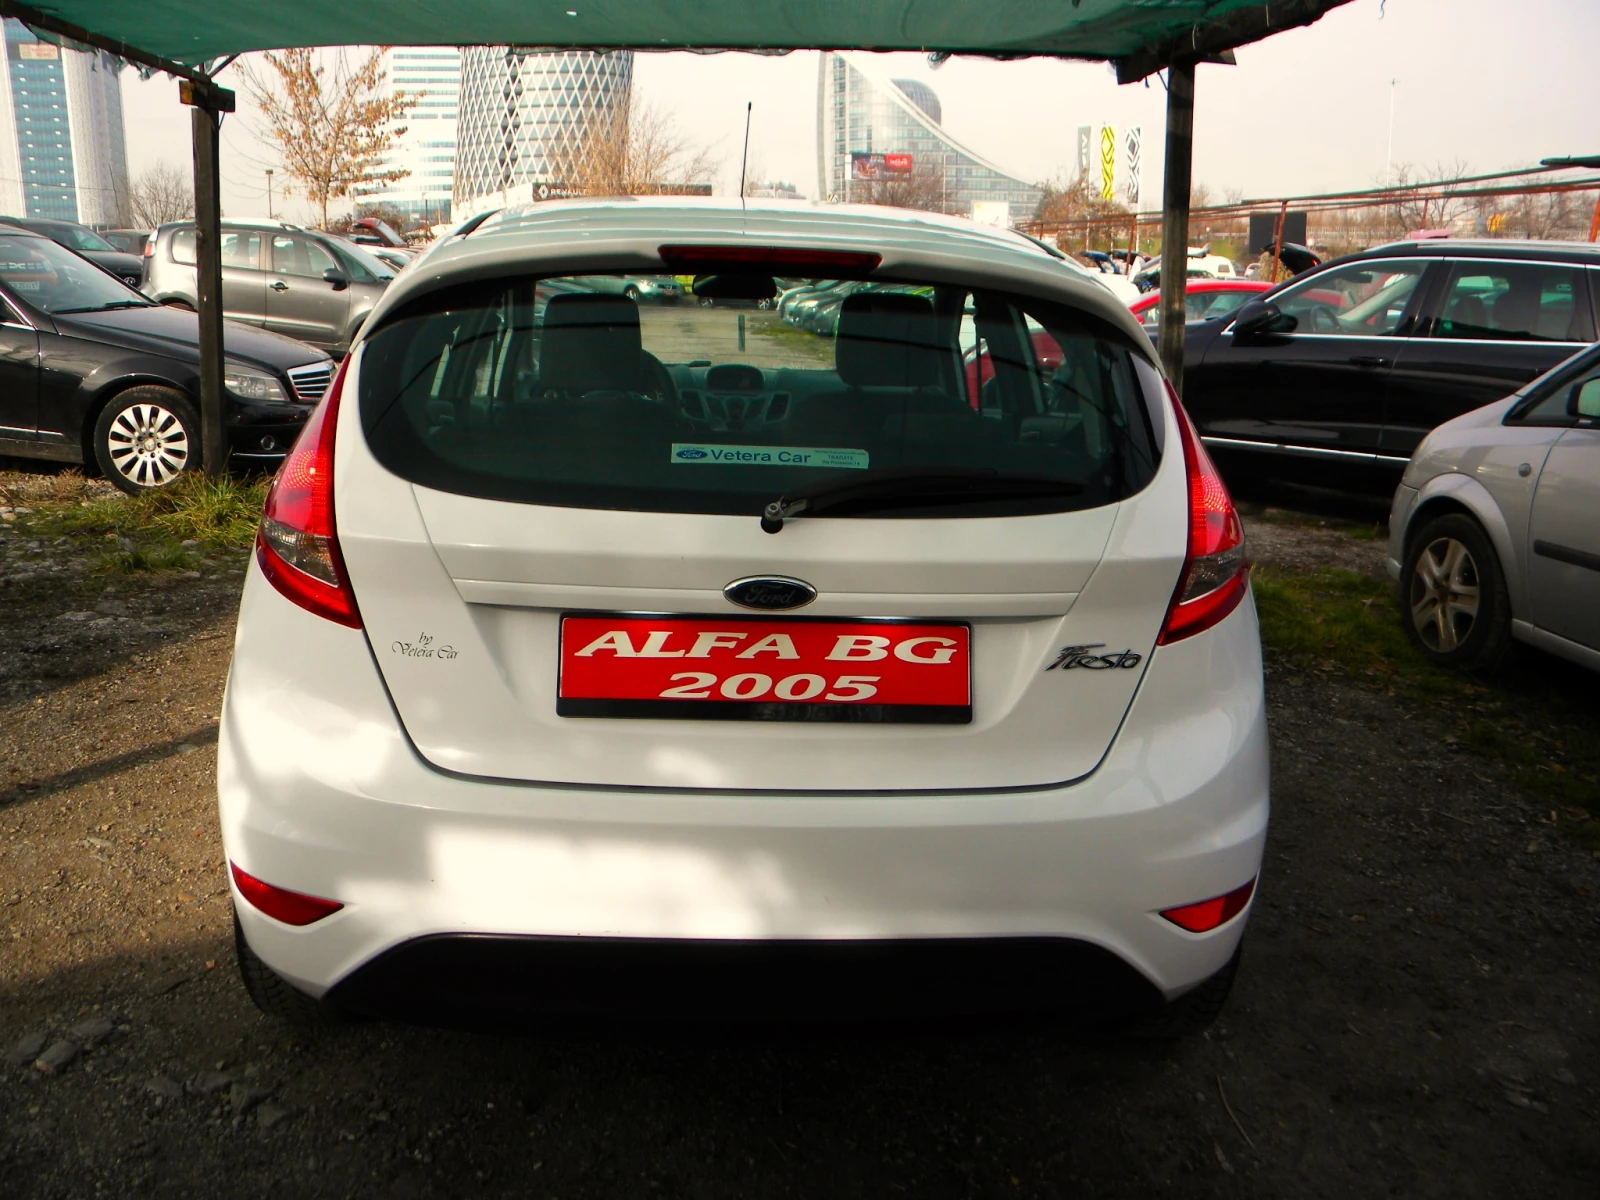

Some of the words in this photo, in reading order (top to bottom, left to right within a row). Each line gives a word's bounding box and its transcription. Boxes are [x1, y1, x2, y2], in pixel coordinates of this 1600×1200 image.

[550, 188, 588, 196] RENAULT
[711, 449, 772, 462] Vetera
[777, 451, 812, 463] Car
[744, 583, 796, 604] Ford
[418, 632, 433, 648] by
[574, 630, 800, 660] ALFA
[824, 635, 958, 664] BG
[391, 641, 434, 658] Vetera
[437, 645, 460, 659] Car
[1044, 643, 1143, 672] Fiesta
[658, 672, 882, 702] 2005
